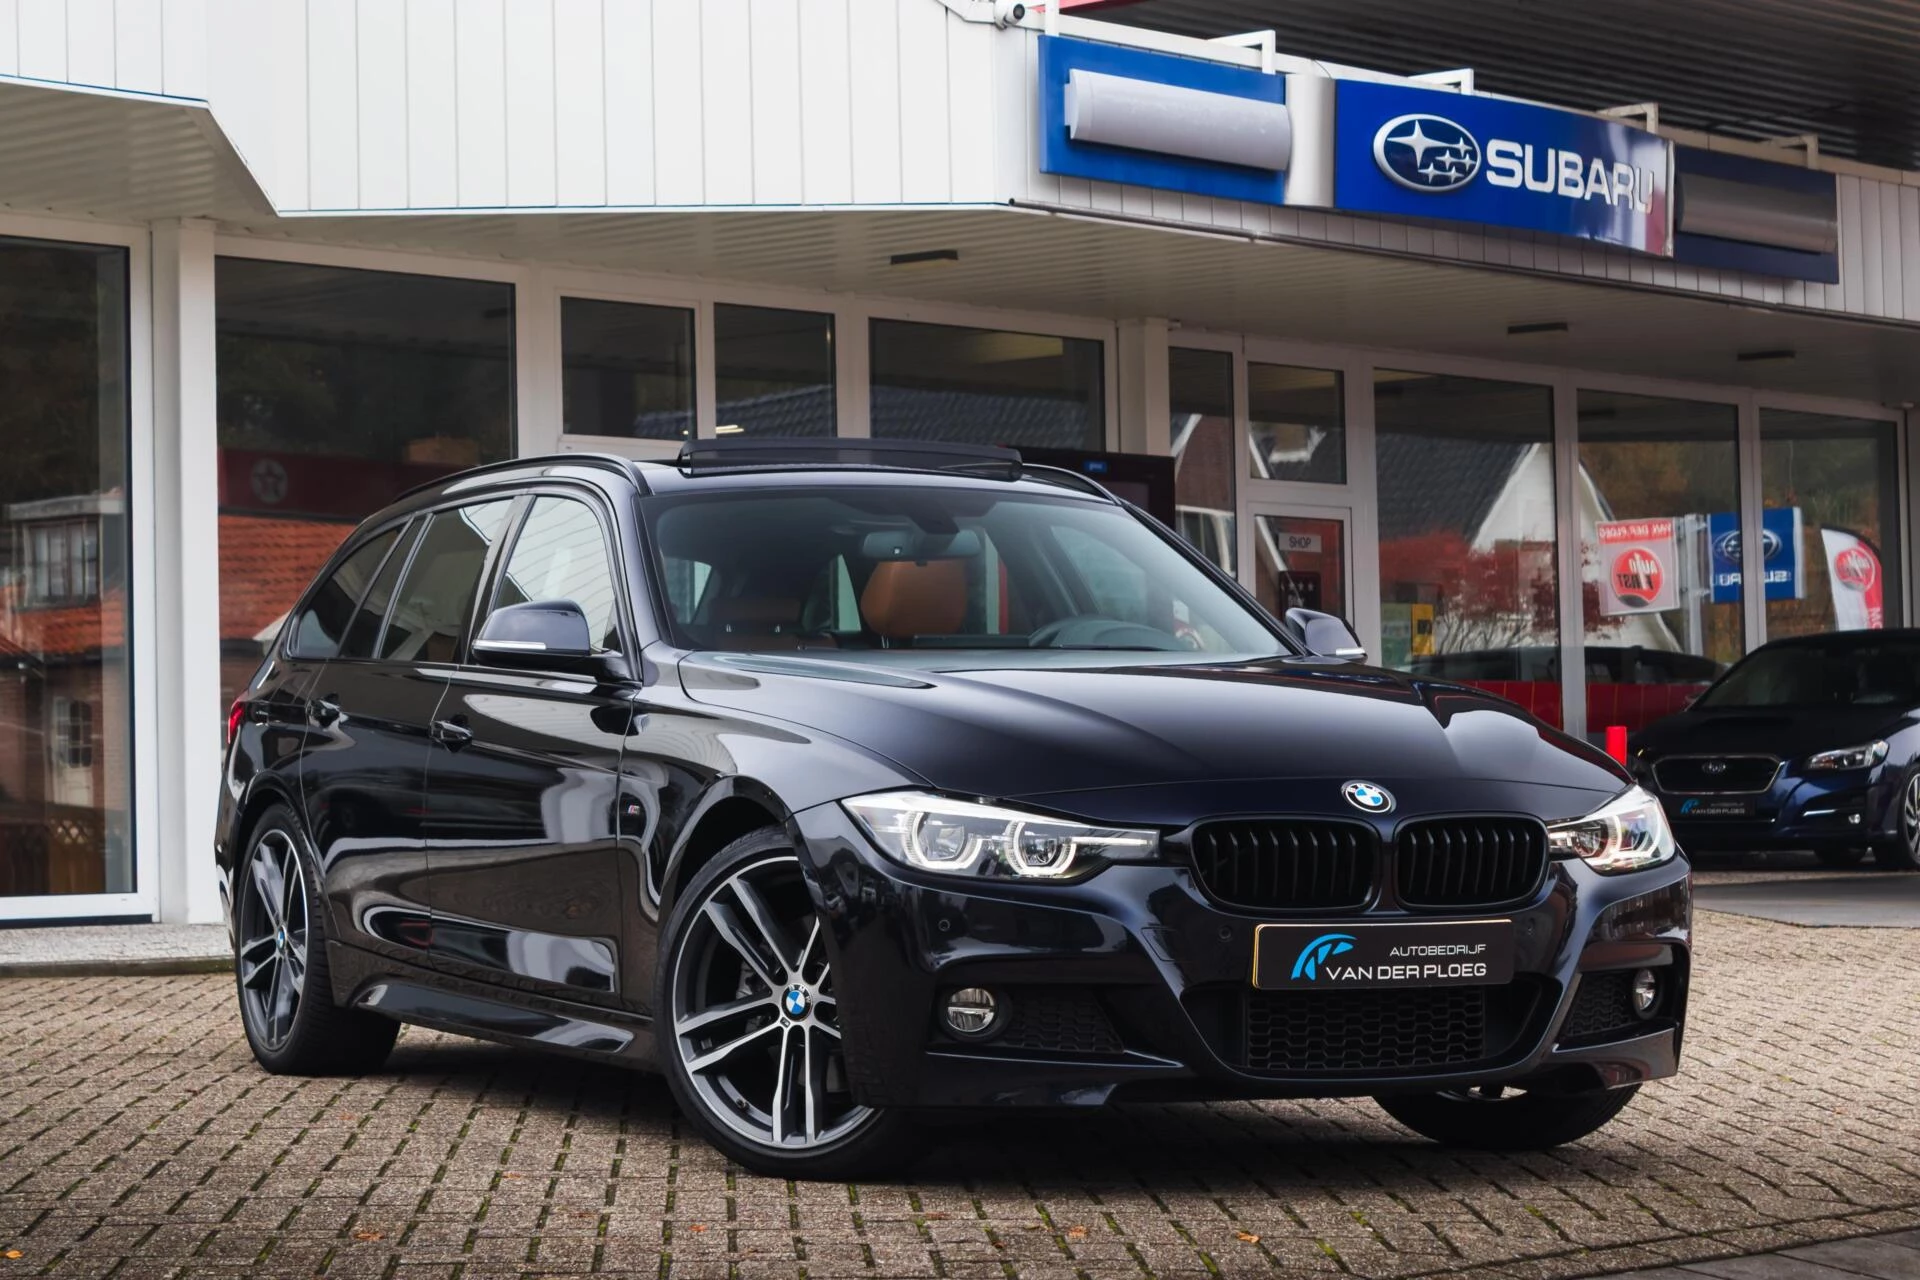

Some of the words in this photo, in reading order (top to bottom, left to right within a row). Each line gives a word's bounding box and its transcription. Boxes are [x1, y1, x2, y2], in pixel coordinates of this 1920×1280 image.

[1486, 138, 1654, 214] SUBARU
[1289, 537, 1311, 548] SHOP
[1390, 943, 1486, 957] AUTOBEDRIJF
[1326, 966, 1373, 980] VAN
[1378, 965, 1420, 980] DER
[1424, 963, 1487, 978] PLOEG
